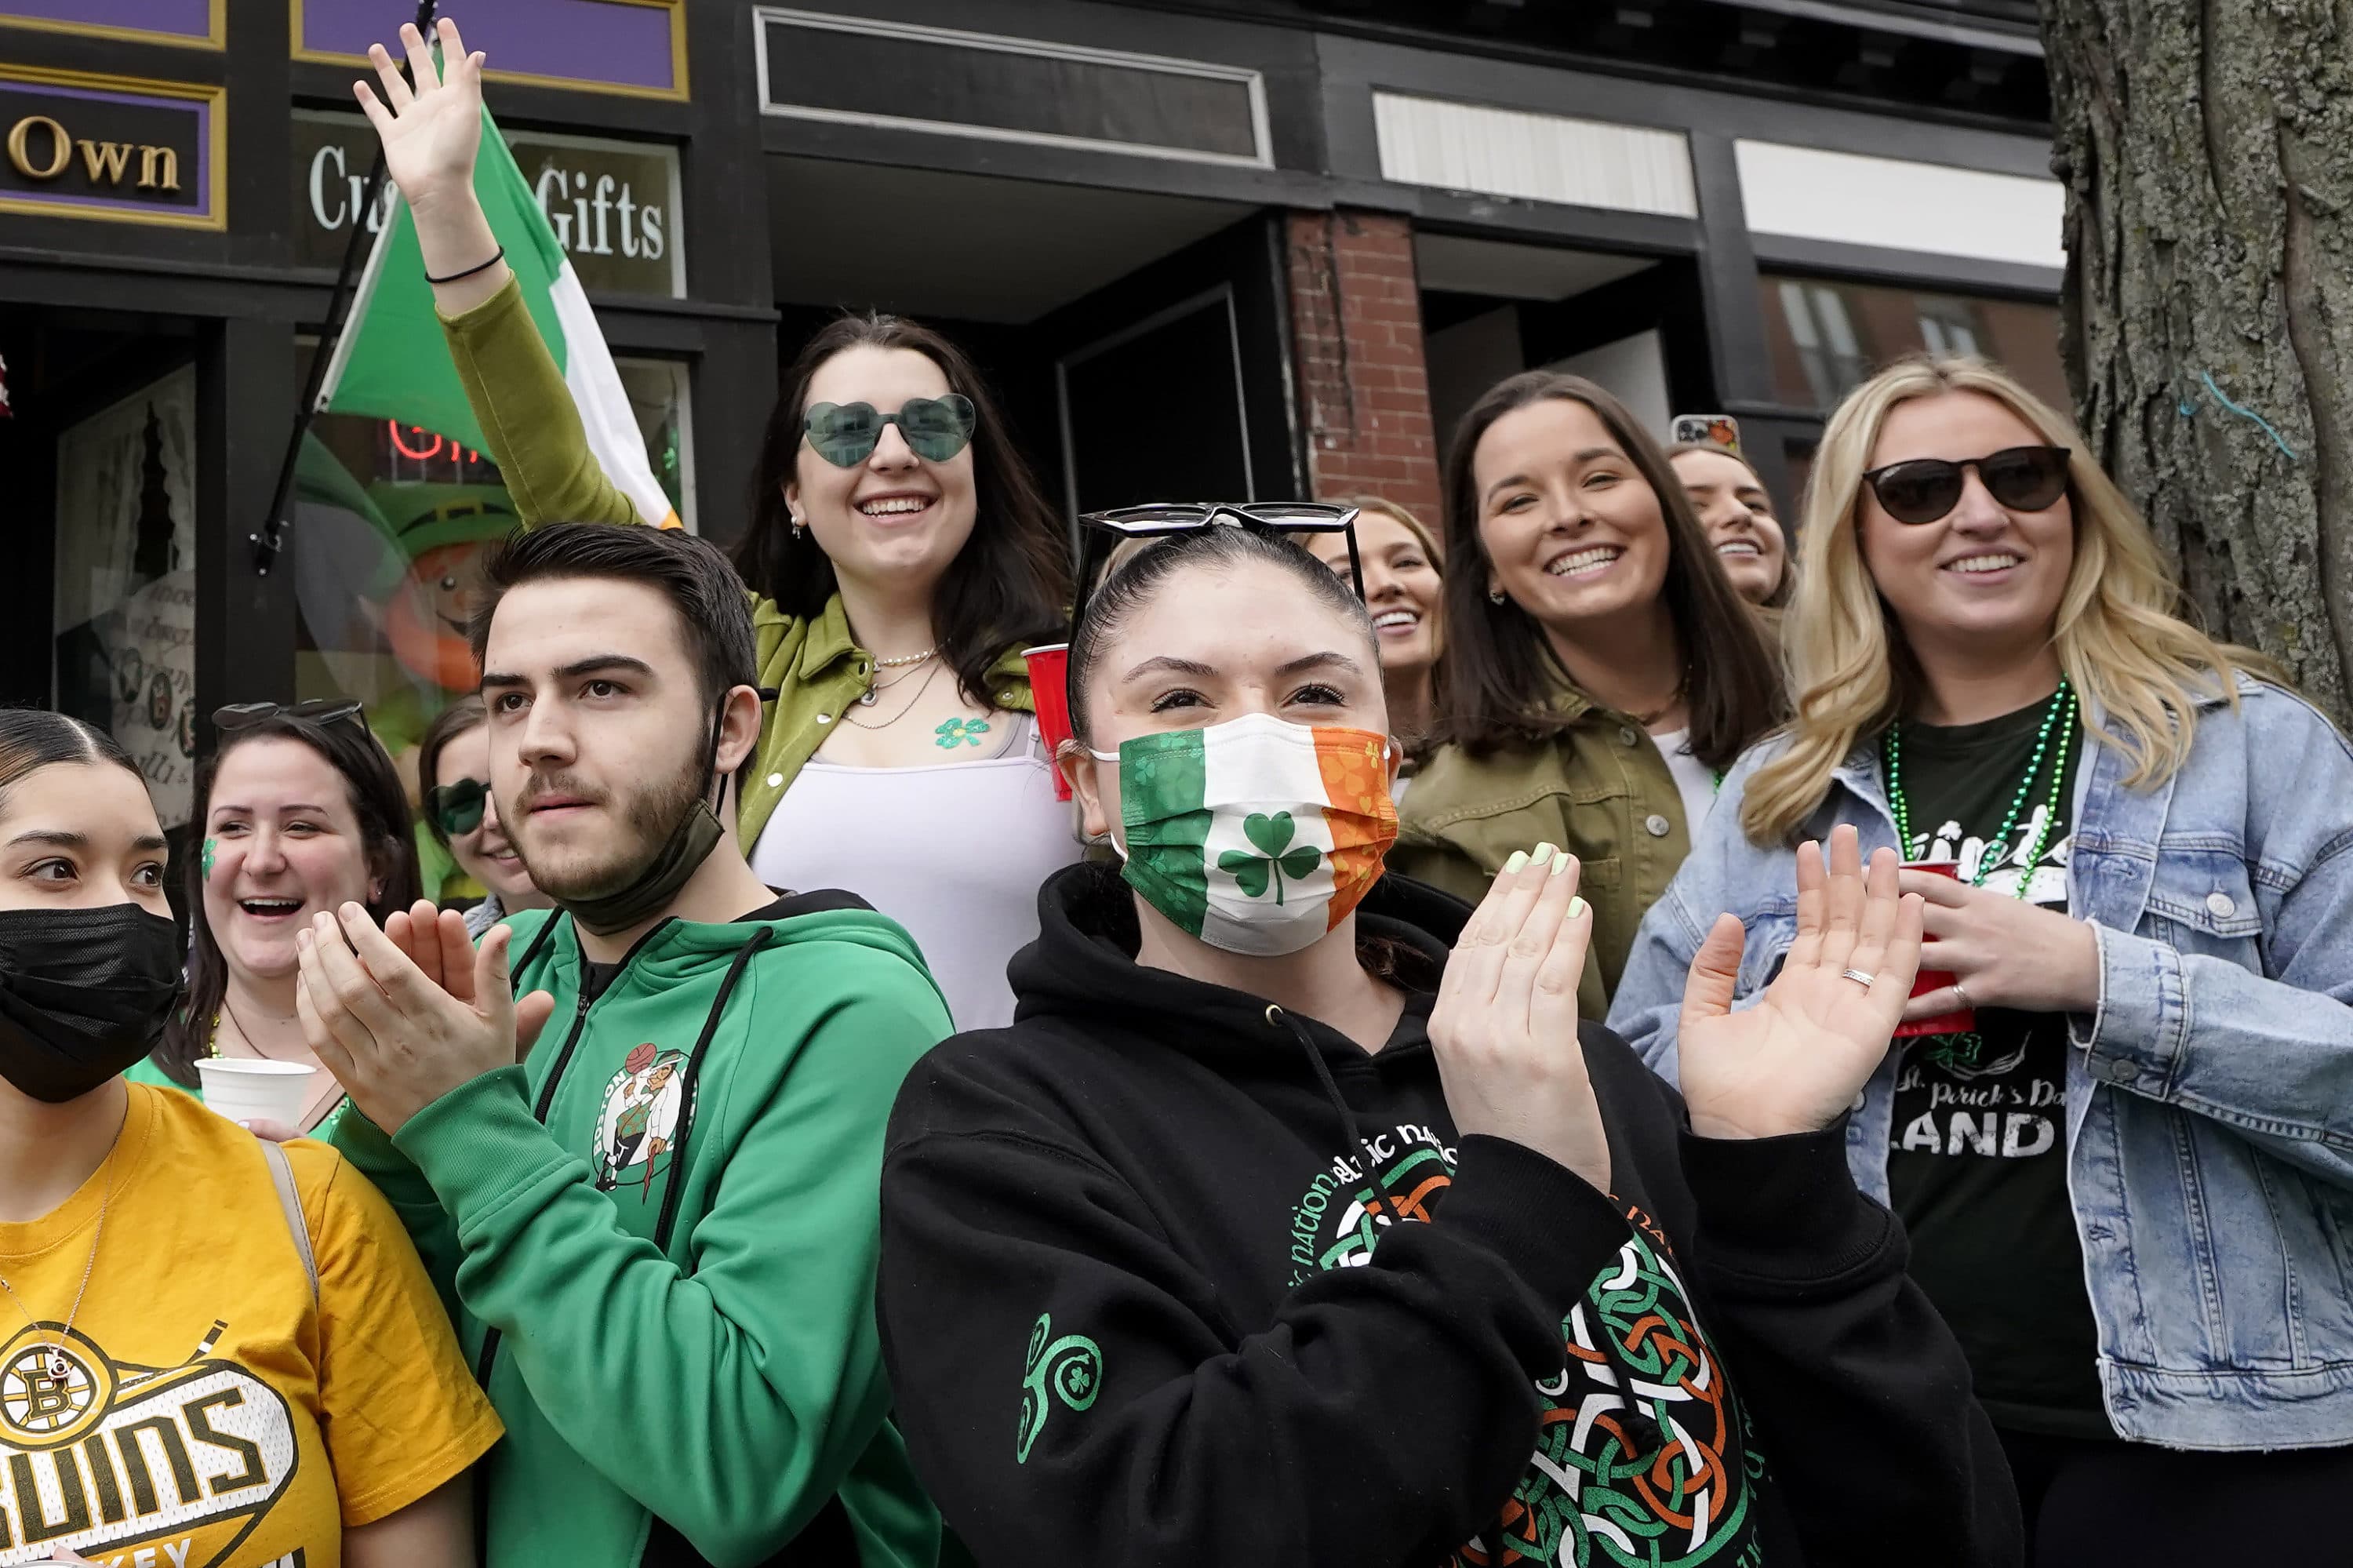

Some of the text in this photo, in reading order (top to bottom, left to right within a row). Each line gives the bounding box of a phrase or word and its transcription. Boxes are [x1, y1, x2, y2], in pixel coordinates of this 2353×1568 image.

[8, 115, 181, 191] Own
[535, 168, 665, 260] Gifts
[1890, 1110, 2055, 1158] AND
